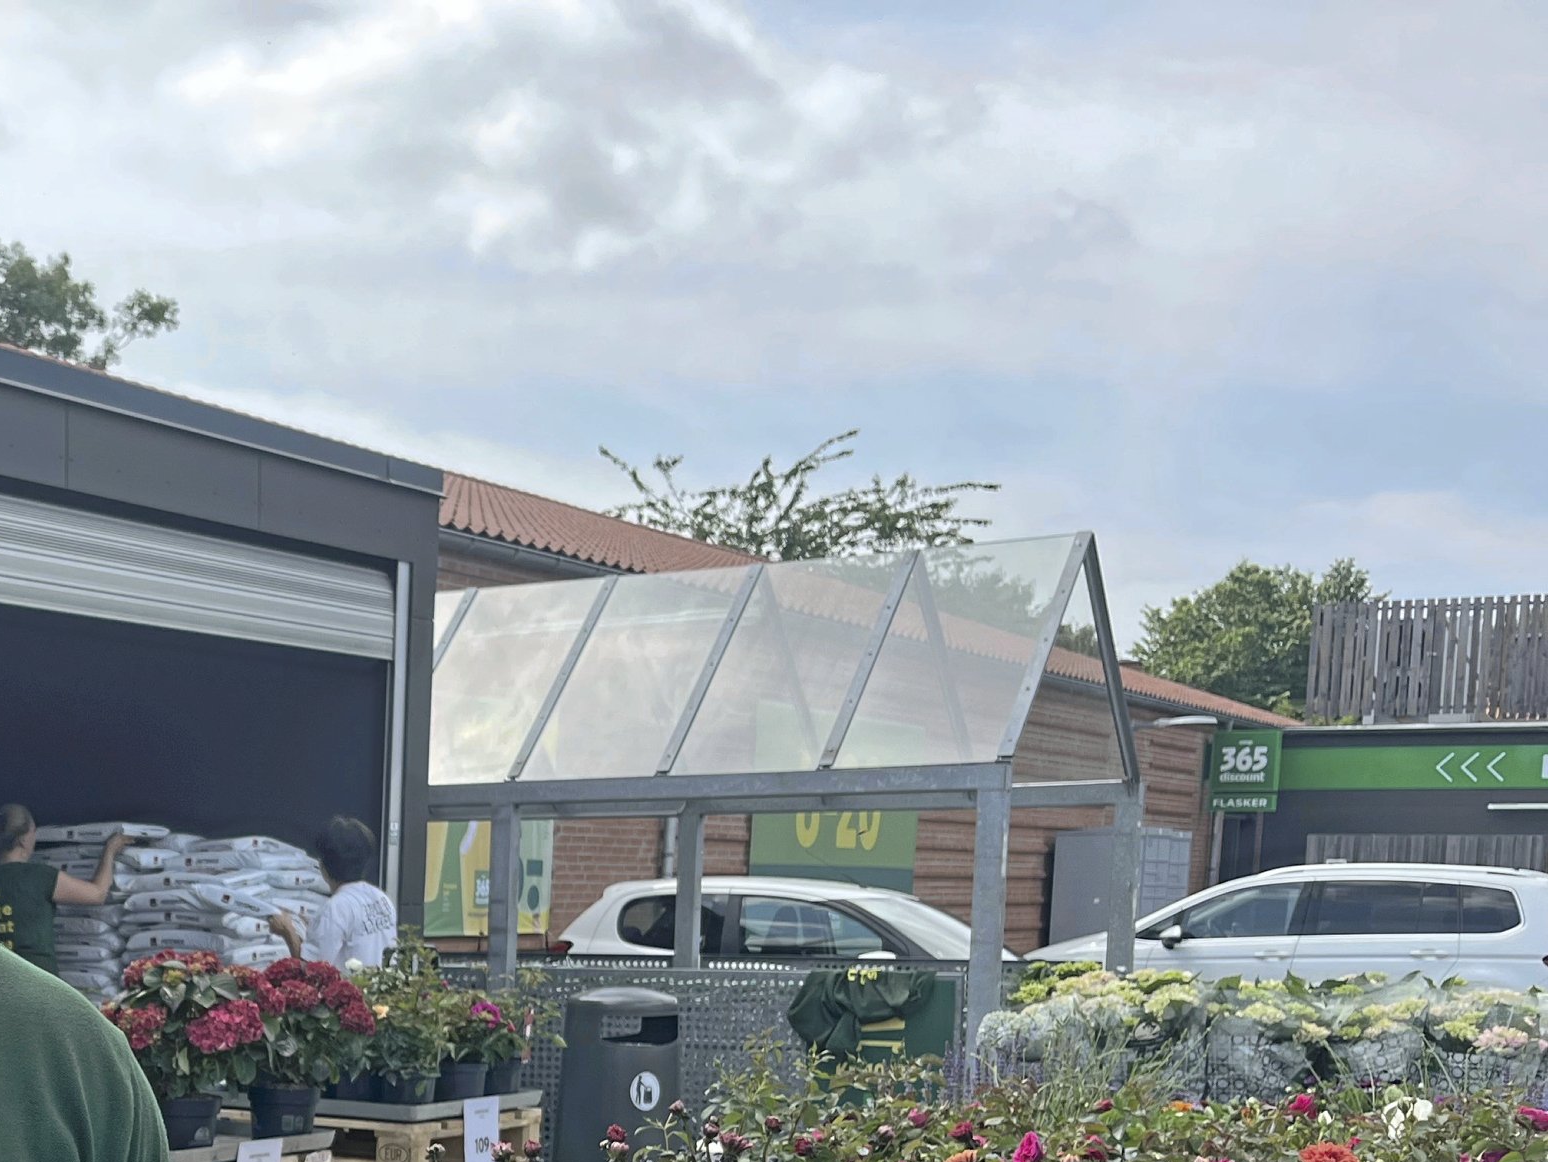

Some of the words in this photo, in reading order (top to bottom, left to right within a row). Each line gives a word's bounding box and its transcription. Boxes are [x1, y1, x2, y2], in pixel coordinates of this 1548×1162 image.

[1220, 746, 1268, 773] 365
[1219, 772, 1266, 783] discount
[1212, 798, 1268, 808] FLASKER
